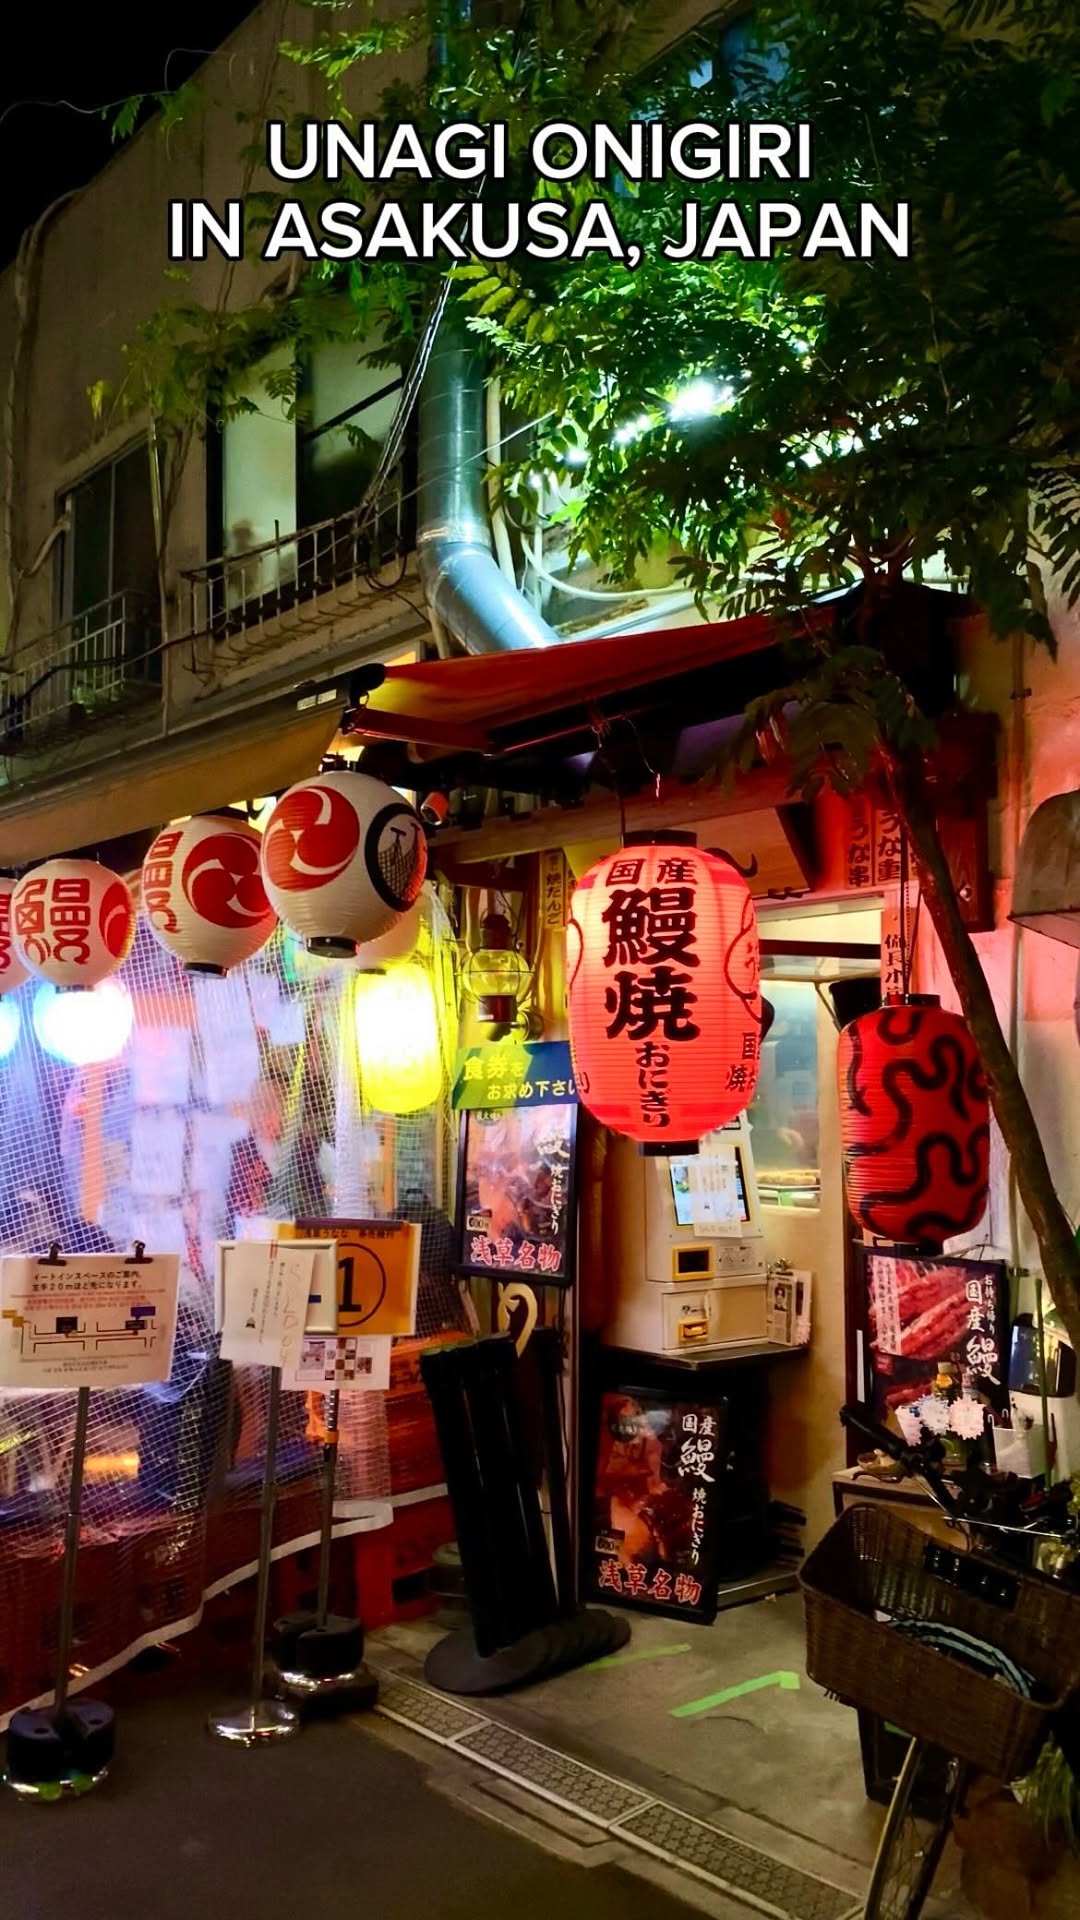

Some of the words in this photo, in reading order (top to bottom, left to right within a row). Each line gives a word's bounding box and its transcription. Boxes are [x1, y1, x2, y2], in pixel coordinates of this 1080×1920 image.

[605, 857, 699, 887] 国産
[463, 1055, 525, 1081] 食券を
[635, 1041, 671, 1128] おにぎり
[470, 1235, 563, 1272] 浅草名物
[681, 1413, 717, 1437] 国産
[677, 1438, 716, 1483] 鰻
[690, 1487, 708, 1565] 焼おにぎり
[598, 1558, 703, 1605] 浅草名物
